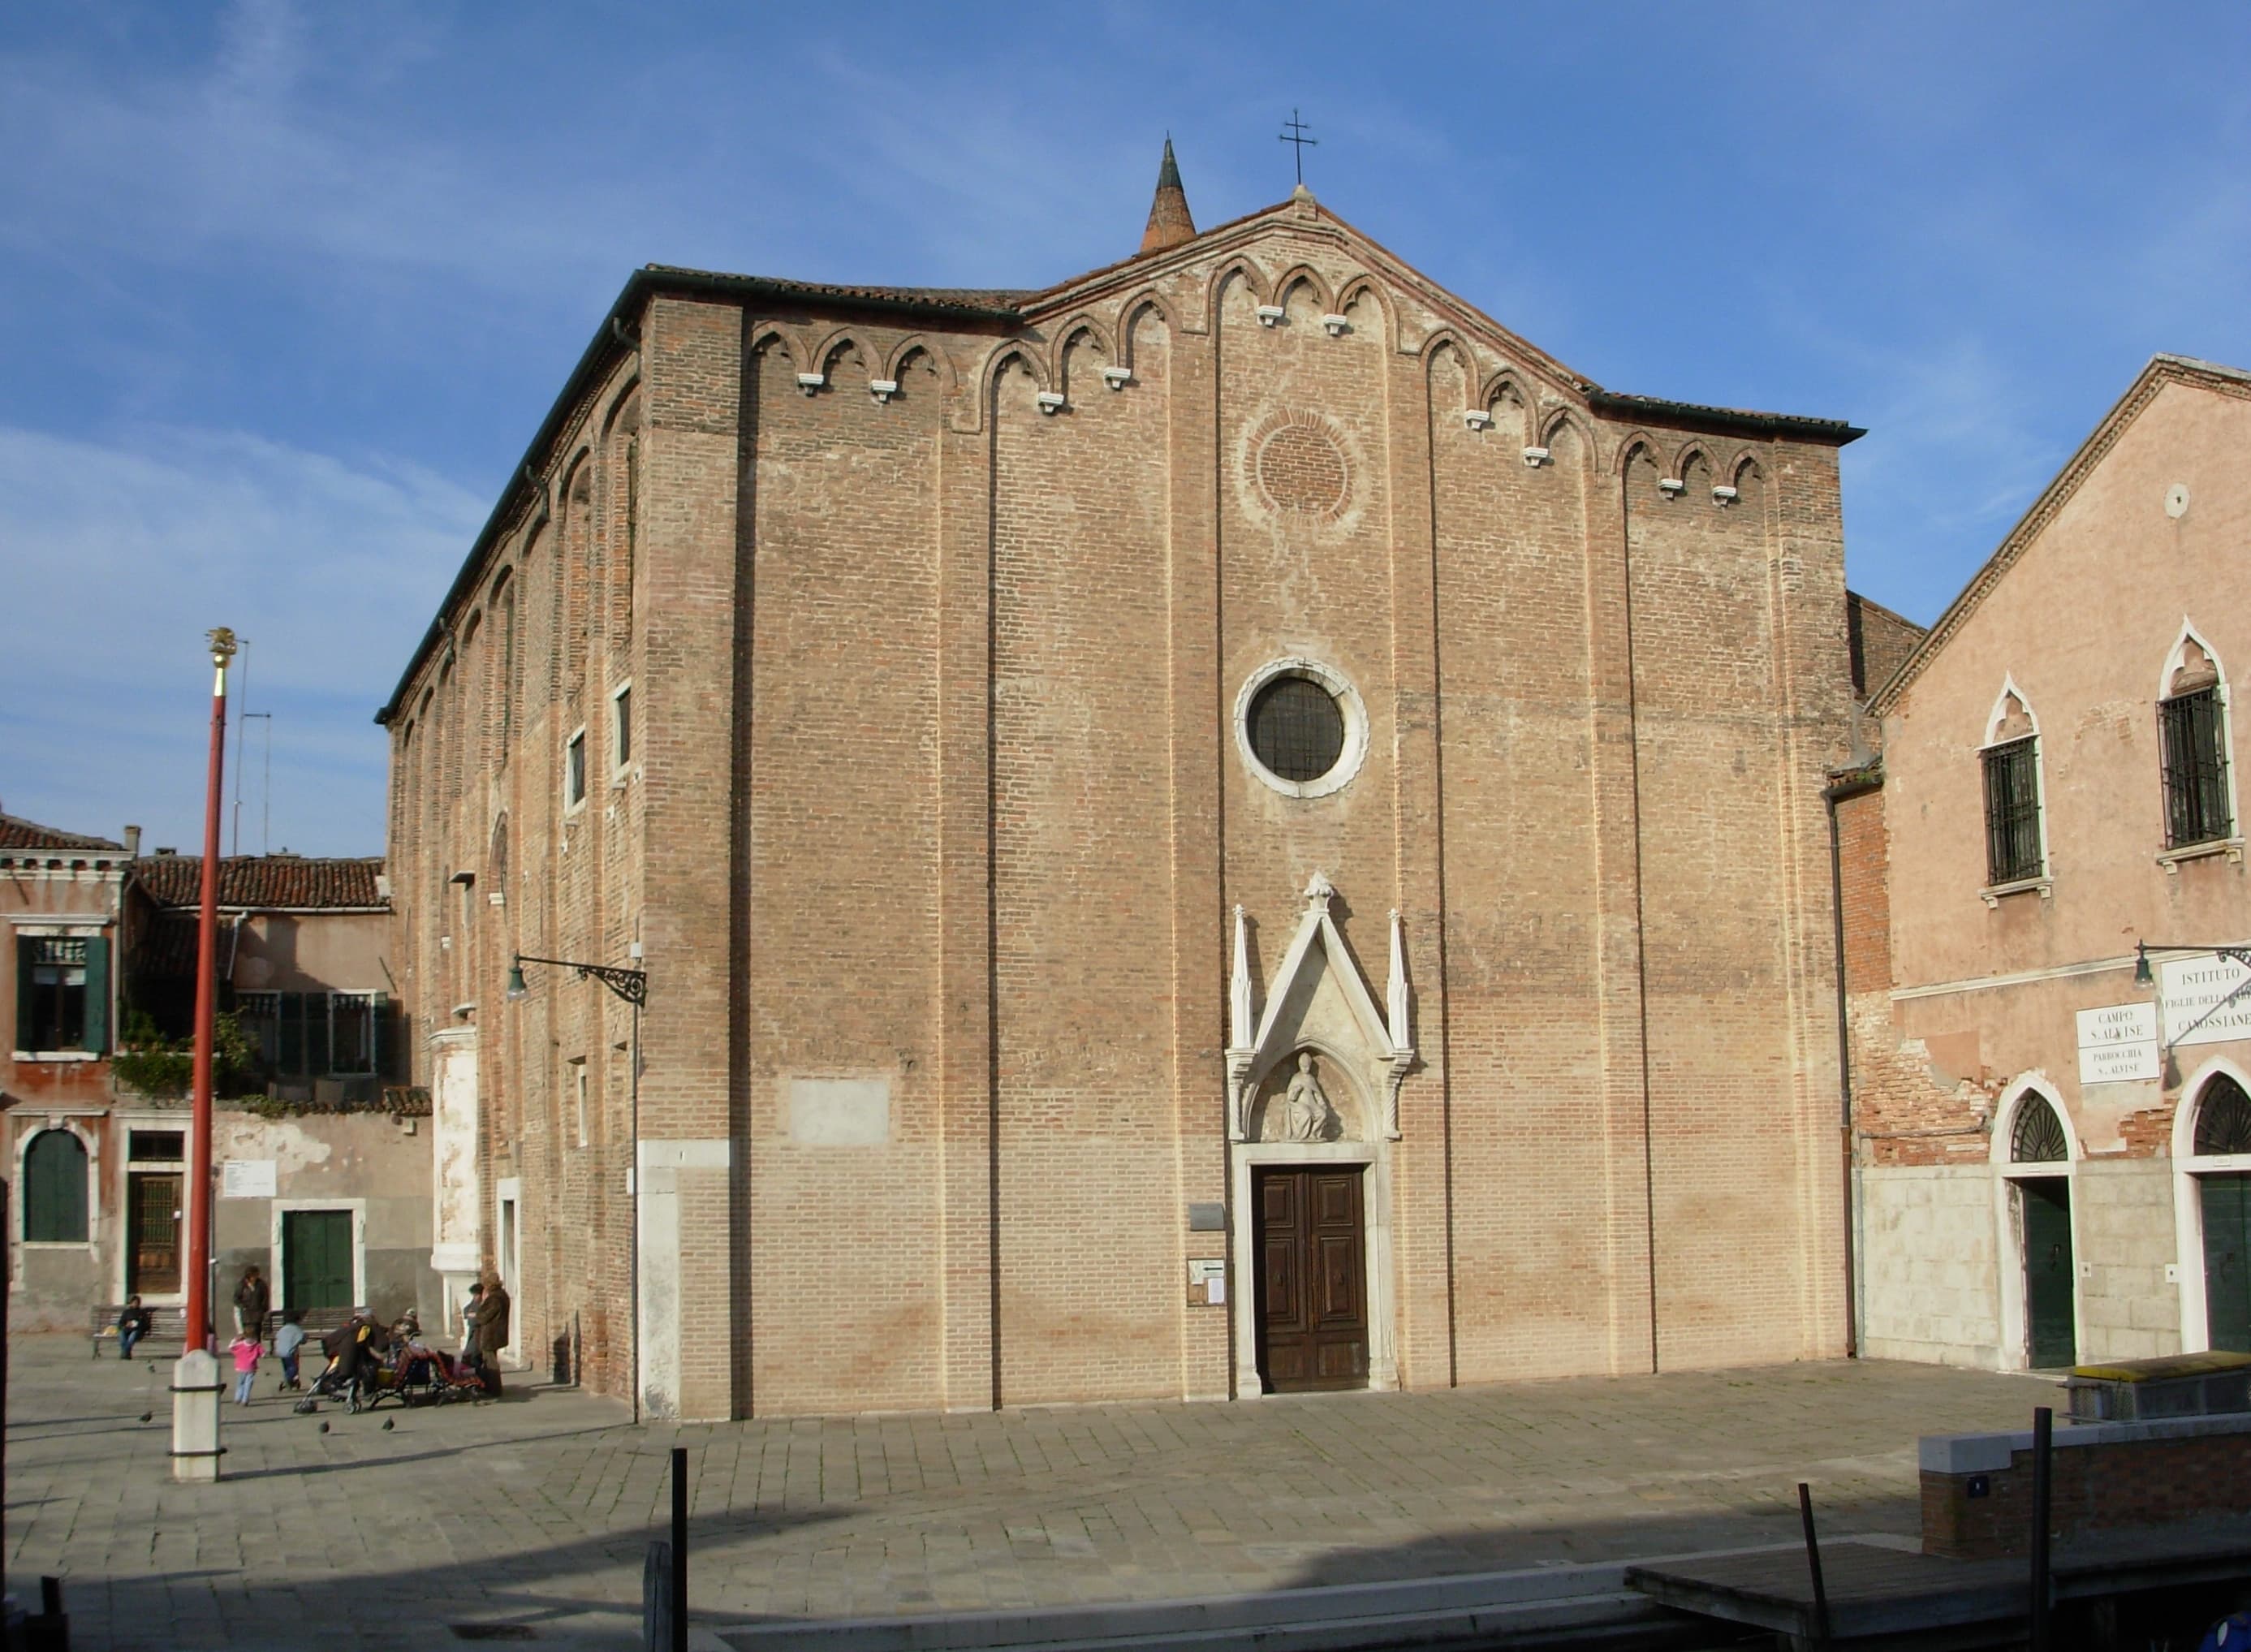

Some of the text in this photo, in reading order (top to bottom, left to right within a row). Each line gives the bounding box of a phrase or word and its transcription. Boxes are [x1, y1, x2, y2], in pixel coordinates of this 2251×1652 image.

[2182, 967, 2240, 986] ISTITUTO
[2165, 996, 2195, 1010] FIGLIE
[2098, 1011, 2133, 1024] CAMPO
[2103, 1024, 2143, 1040] ALVISE
[2093, 1048, 2142, 1063] PARROCCHIA
[2111, 1062, 2141, 1075] ALVISE
